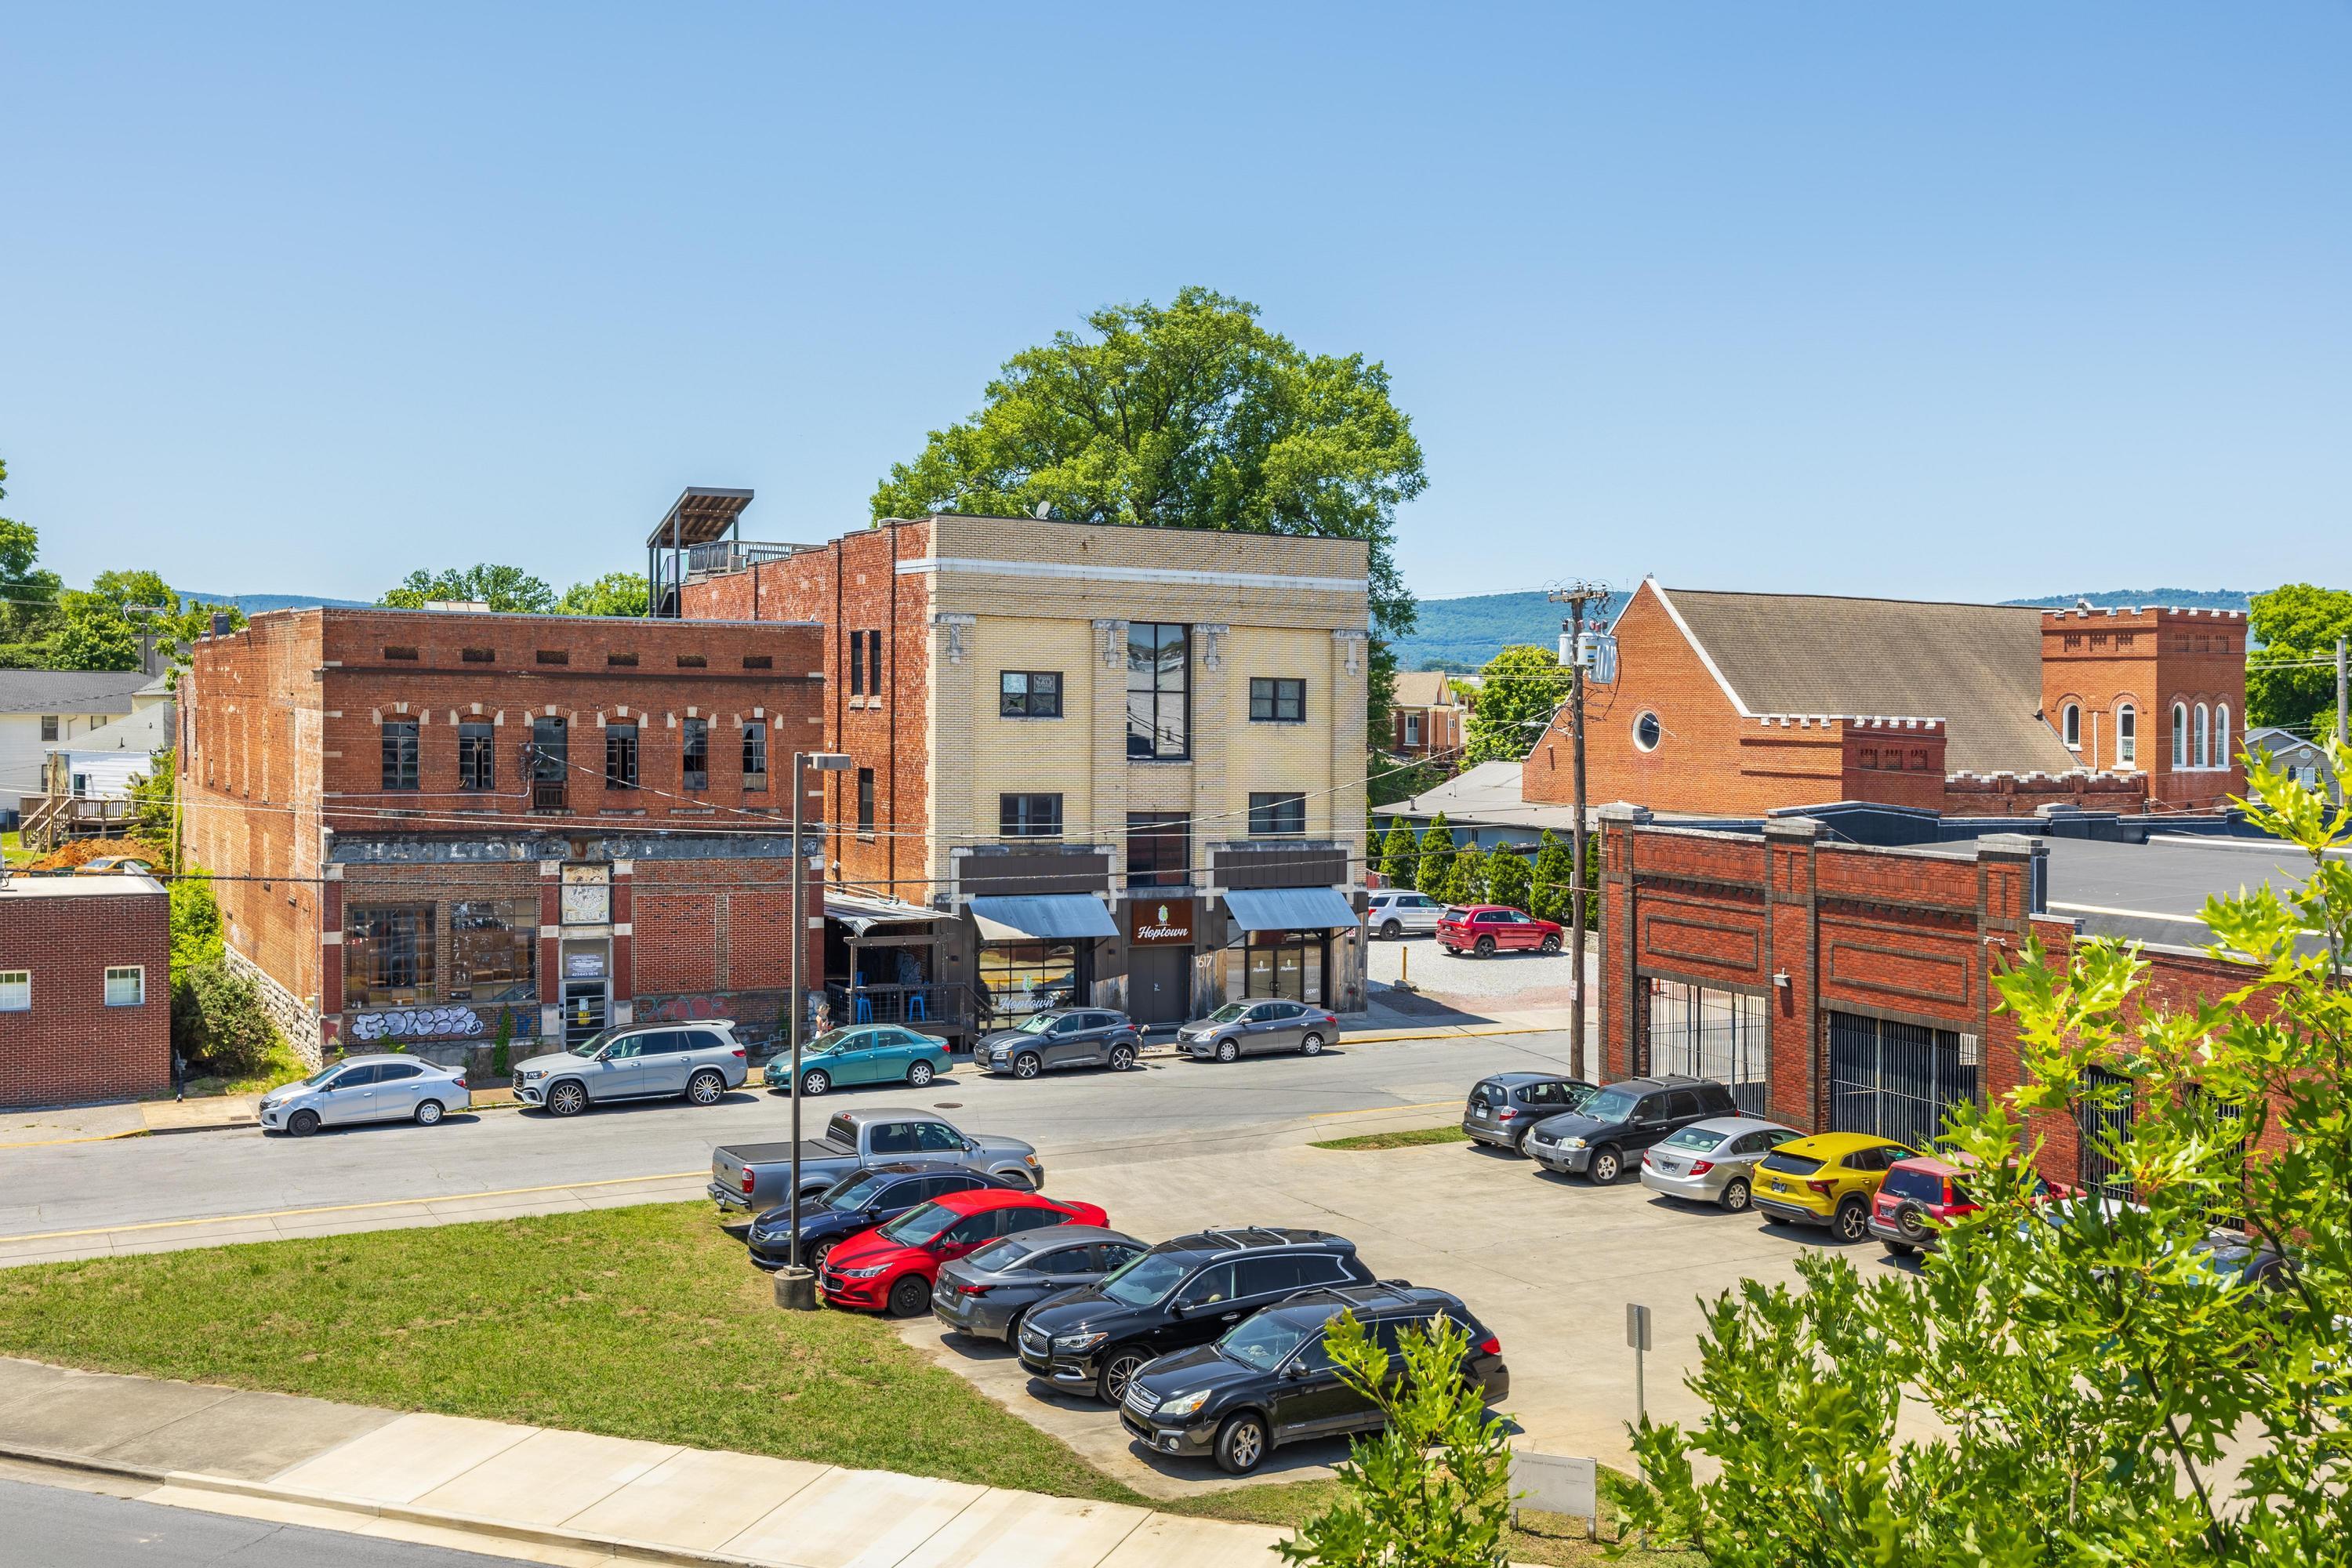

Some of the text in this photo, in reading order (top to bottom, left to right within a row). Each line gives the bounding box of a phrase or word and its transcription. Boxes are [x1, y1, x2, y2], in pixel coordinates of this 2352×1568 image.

[1138, 926, 1189, 940] Hoptown
[1195, 956, 1213, 968] 1617
[998, 996, 1055, 1013] Hoptown
